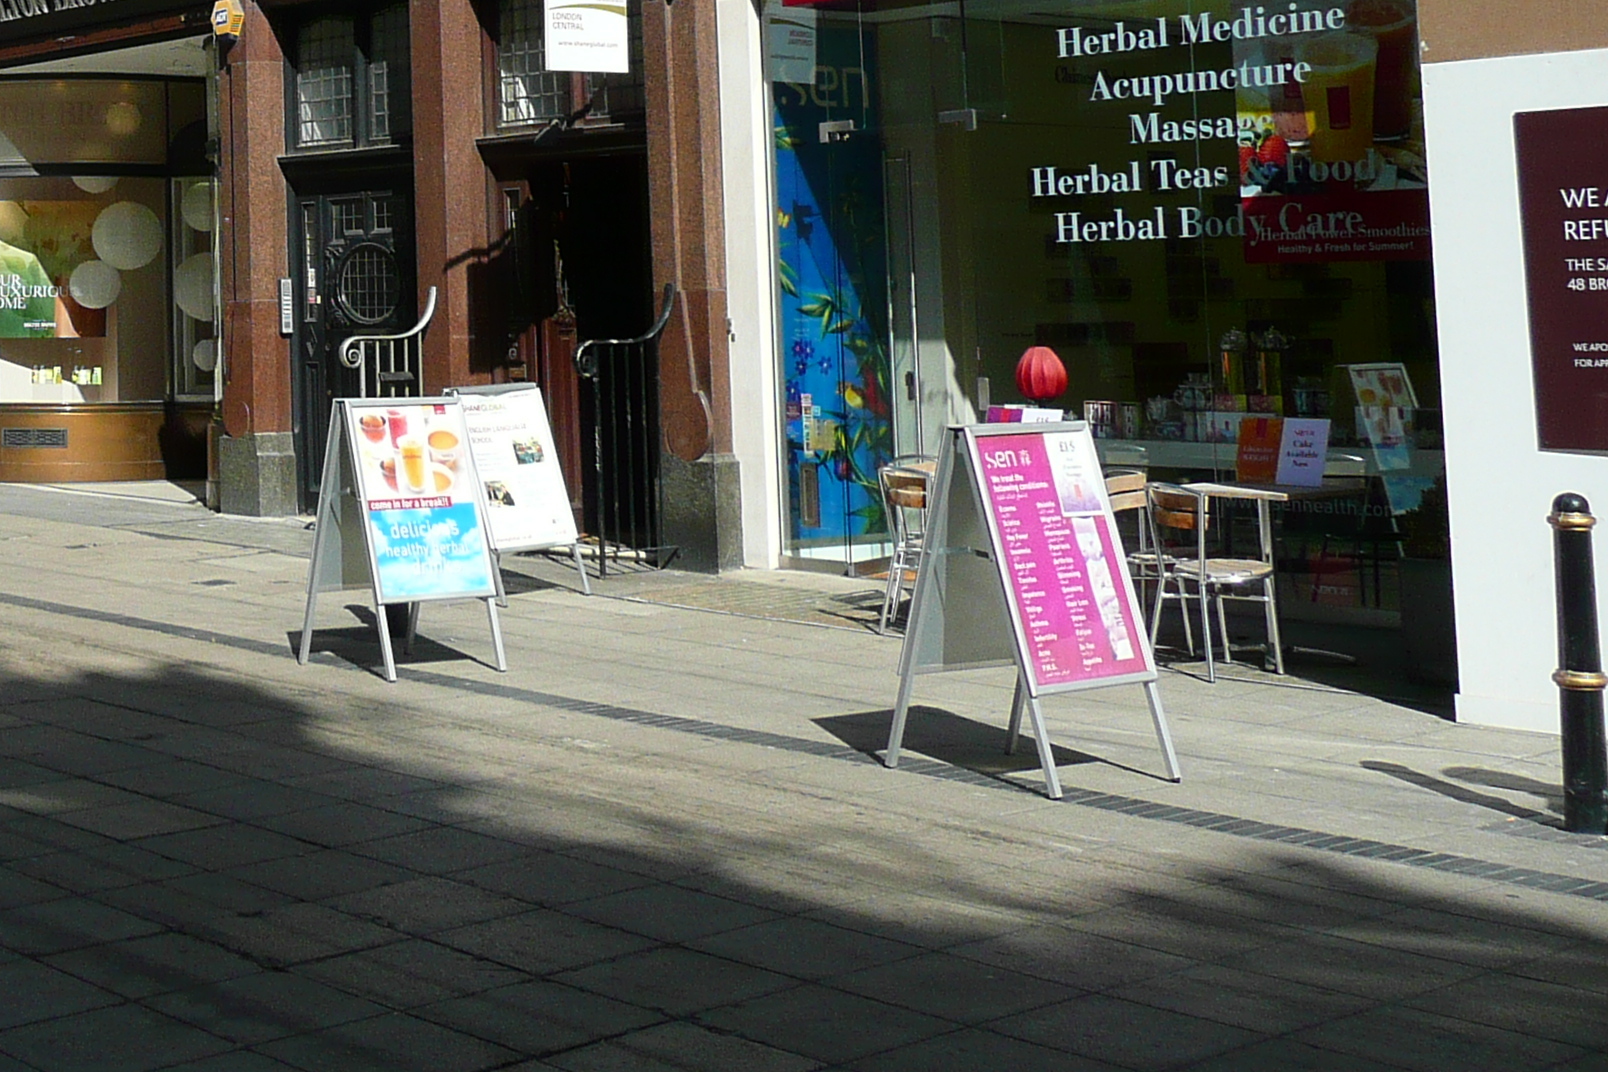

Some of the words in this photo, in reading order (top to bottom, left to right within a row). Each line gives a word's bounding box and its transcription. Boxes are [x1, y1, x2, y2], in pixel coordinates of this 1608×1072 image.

[552, 12, 582, 20] LONDON
[552, 22, 584, 30] CENTRAL
[1056, 17, 1168, 58] Herbal
[1179, 2, 1345, 45] Medicine
[1090, 60, 1311, 106] Acupuncture
[1128, 112, 1273, 146] Massage
[1030, 162, 1142, 197] Herbal
[1151, 160, 1228, 191] Teas
[1244, 156, 1269, 186] &
[1286, 148, 1379, 184] Food
[1560, 188, 1599, 208] WE
[1054, 206, 1167, 243] Herbal
[1178, 203, 1265, 246] Body
[1278, 202, 1363, 235] Care
[1261, 226, 1306, 242] Herbal
[1360, 222, 1431, 238] Smoothies
[1278, 244, 1312, 254] Healthy
[1314, 244, 1322, 252] &
[1324, 243, 1351, 253] Fresh
[1353, 242, 1367, 252] for
[1368, 241, 1414, 252] Summer!
[1565, 258, 1594, 272] THE
[1567, 279, 1585, 291] 48
[1589, 279, 1608, 290] BR
[1573, 342, 1590, 352] WE
[1574, 358, 1592, 368] FOR
[370, 501, 392, 510] come
[393, 500, 400, 508] in
[402, 498, 412, 508] for
[1223, 496, 1395, 517] wwsenhealth.co
[390, 519, 460, 538] delicis
[386, 542, 429, 558] healthy
[432, 540, 471, 554] erbal
